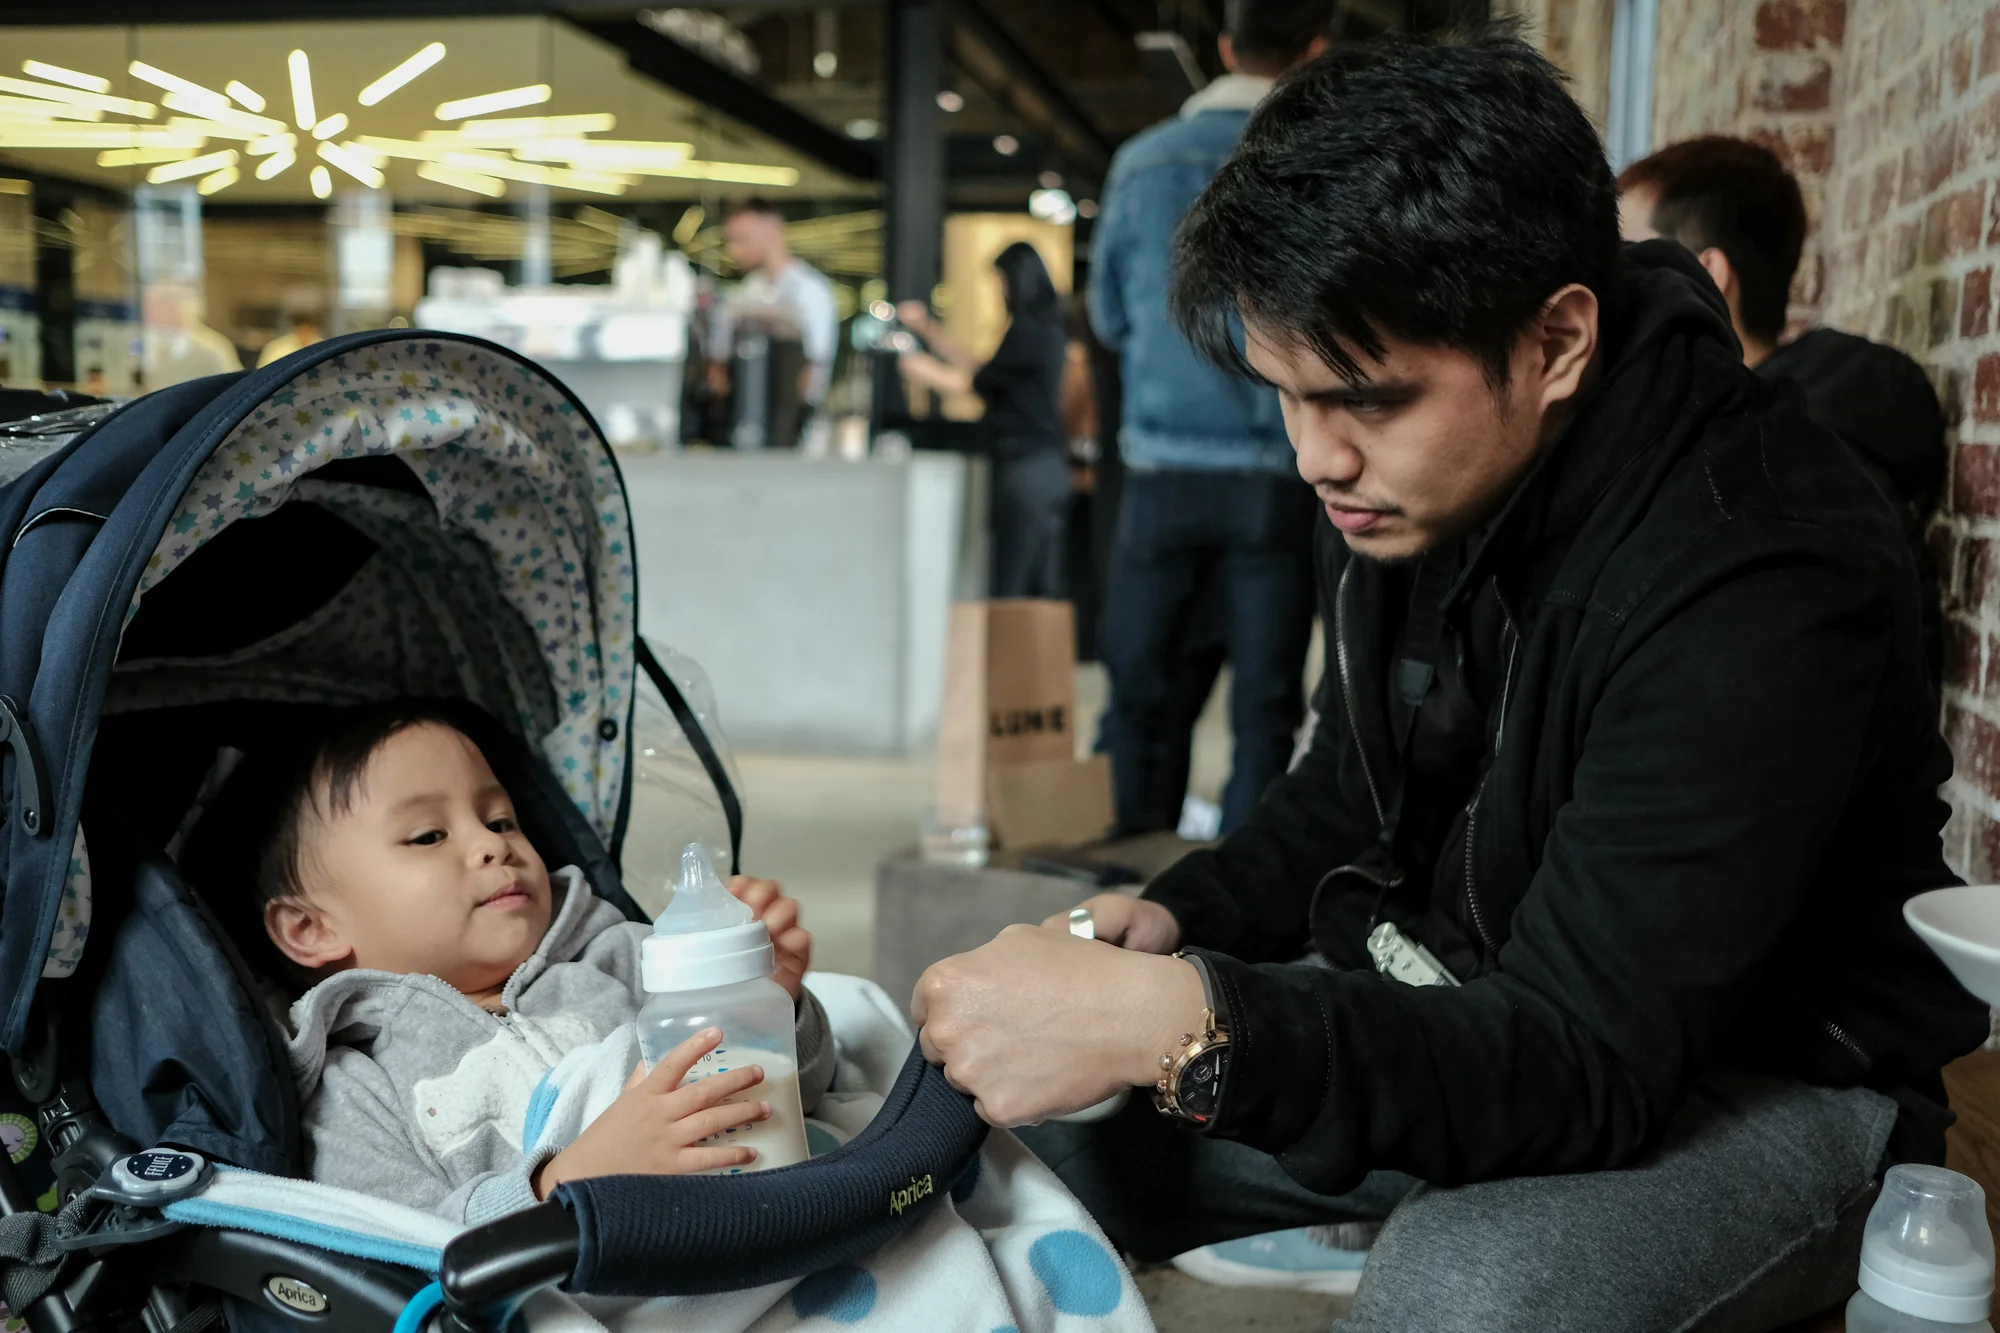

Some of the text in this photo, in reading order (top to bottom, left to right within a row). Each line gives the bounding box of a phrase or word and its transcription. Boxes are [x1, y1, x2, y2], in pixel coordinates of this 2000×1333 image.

[702, 1053, 712, 1062] 10
[144, 1156, 175, 1176] FELICE
[890, 1174, 933, 1216] Aprica
[278, 1283, 316, 1307] Aprica
